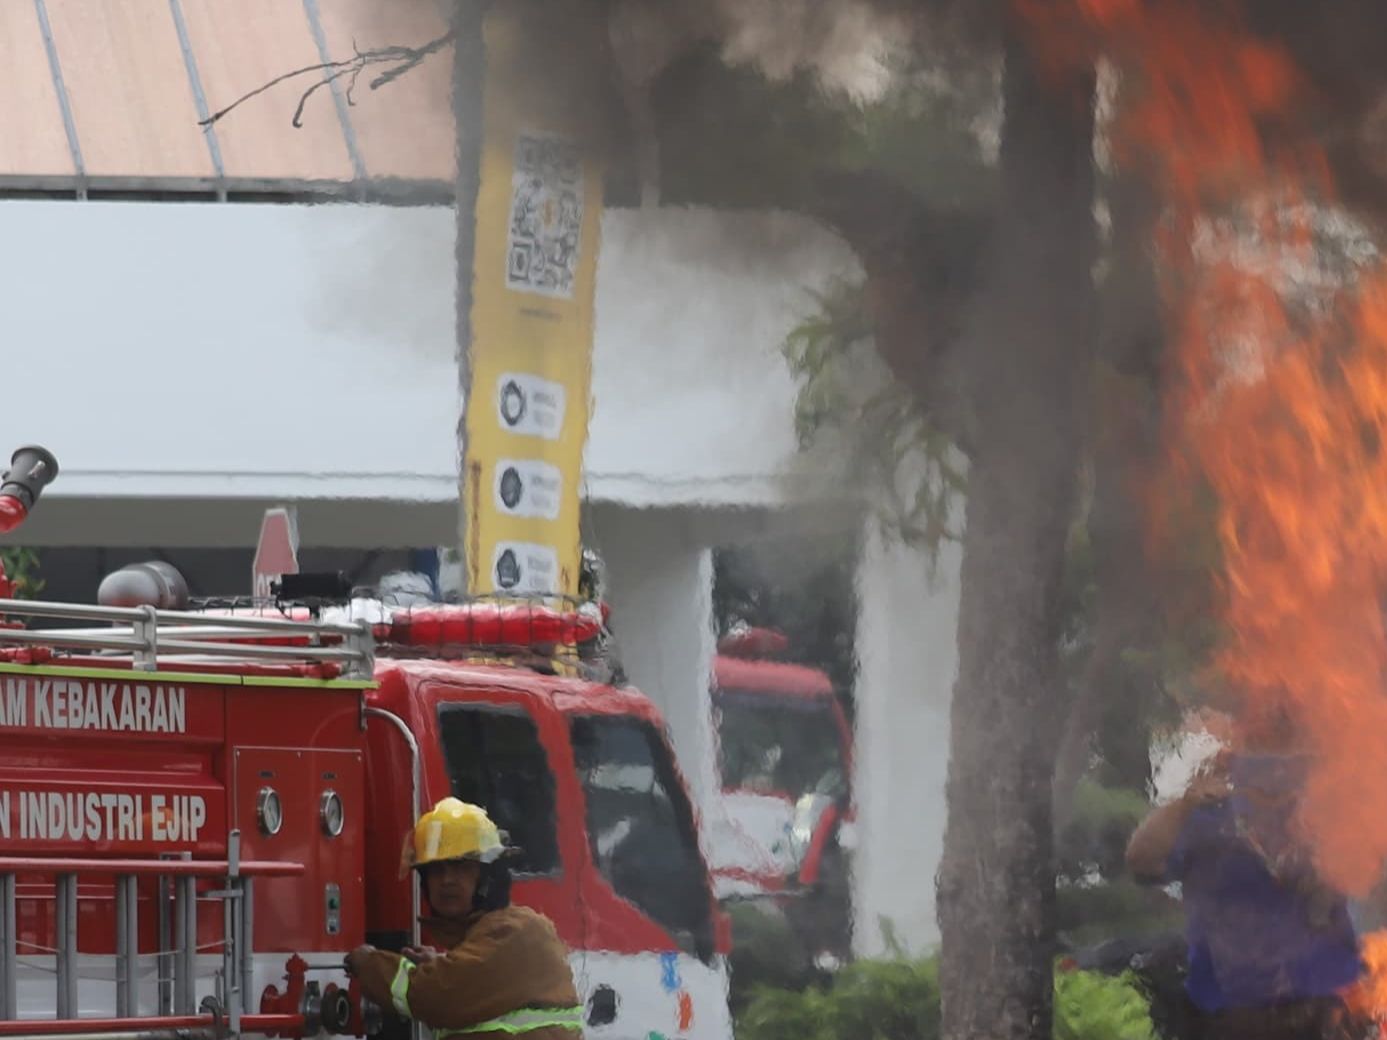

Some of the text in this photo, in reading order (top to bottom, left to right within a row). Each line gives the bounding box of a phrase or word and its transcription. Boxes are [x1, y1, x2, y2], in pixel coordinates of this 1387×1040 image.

[34, 680, 187, 733] KEBAKARAN
[19, 790, 144, 842] INDUSTRI
[151, 794, 207, 842] EJIP
